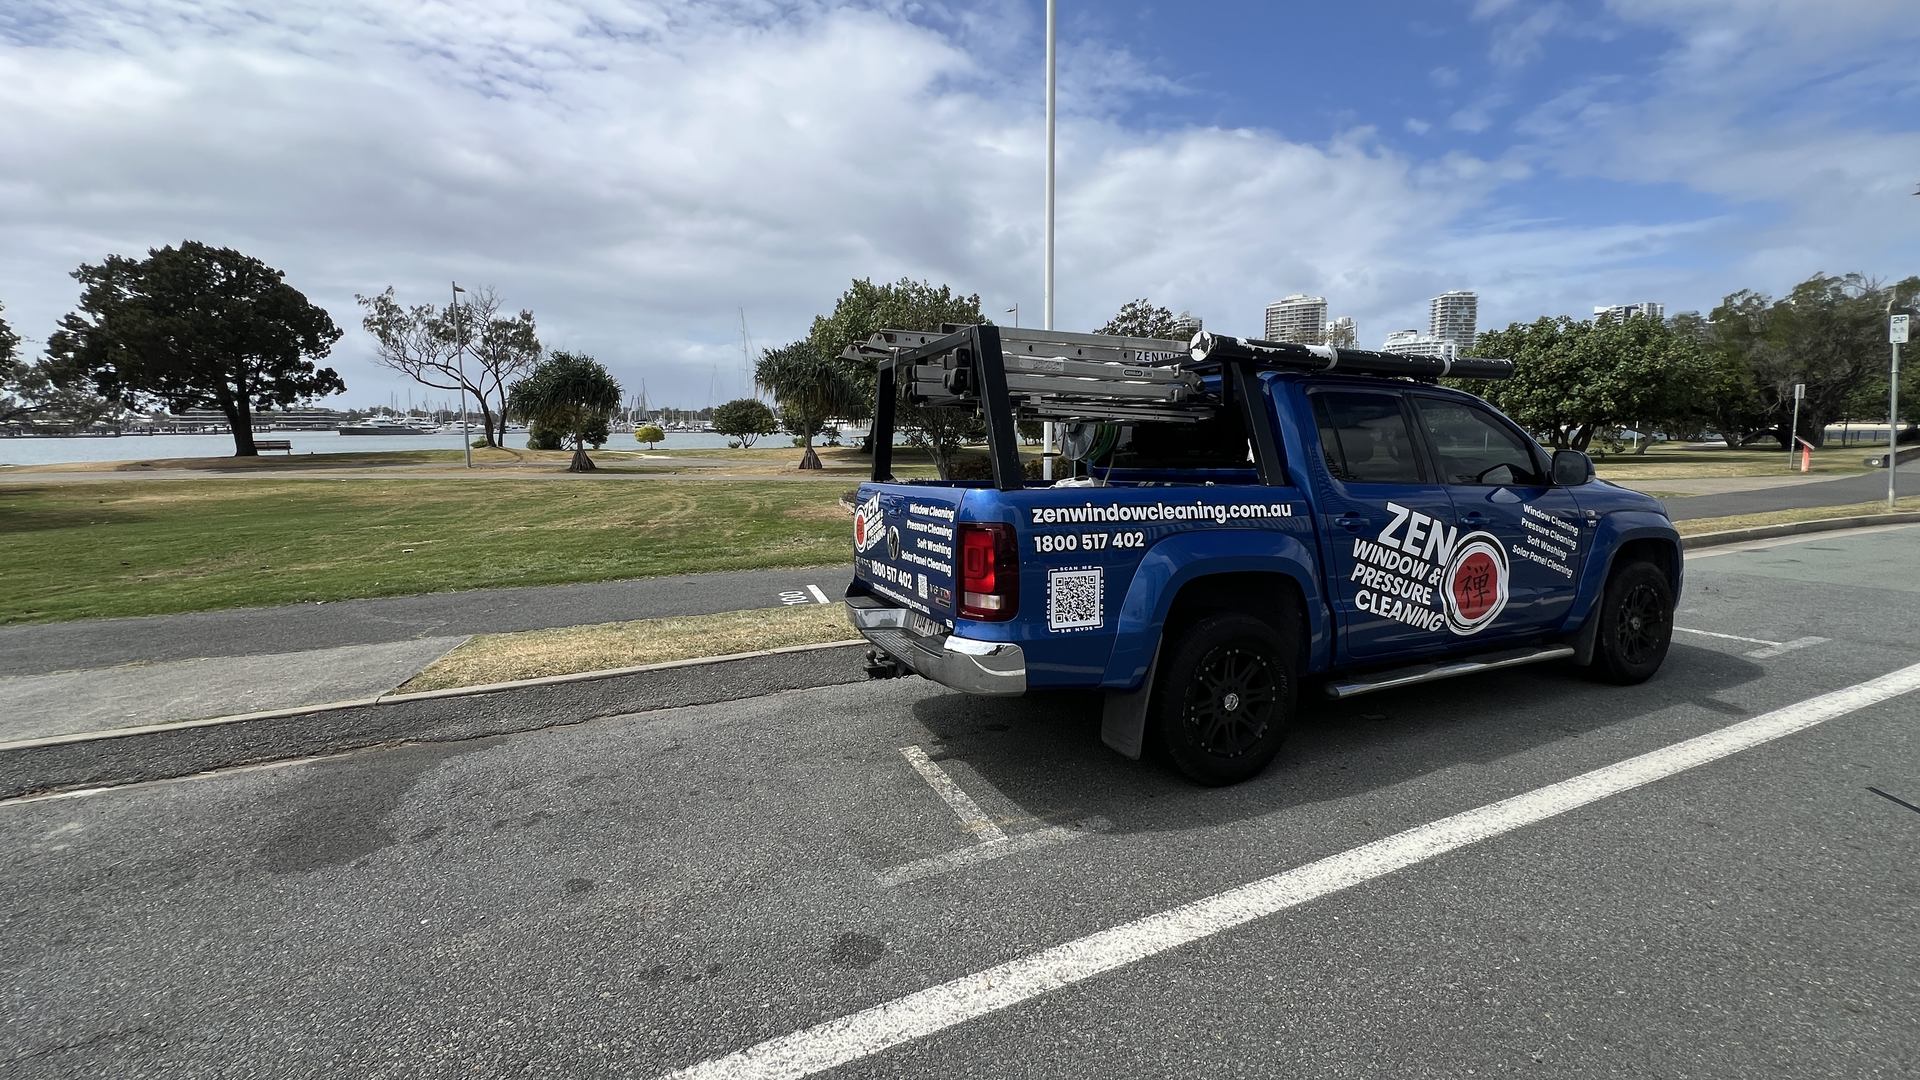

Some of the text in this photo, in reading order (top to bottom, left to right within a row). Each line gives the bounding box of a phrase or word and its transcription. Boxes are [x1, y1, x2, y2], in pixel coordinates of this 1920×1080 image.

[864, 492, 880, 524] ZEN
[909, 502, 954, 522] Window Cleaning
[1032, 502, 1292, 524] zenwindowcleaning.com.au
[1523, 504, 1578, 536] Window Cleaning
[906, 520, 952, 540] Pressure Cleaning
[1034, 532, 1144, 552] 1800 517 402
[1377, 502, 1458, 566] ZEN
[1521, 517, 1577, 550] Pressure Cleaning
[917, 538, 952, 559] Soft Washing
[1352, 538, 1441, 586] WINDOW &
[1512, 544, 1573, 578] Solar Panel Cleaning
[1527, 534, 1568, 561] Soft Washing
[872, 560, 886, 578] 1800
[886, 566, 898, 583] 517
[898, 570, 912, 590] 402
[902, 550, 952, 578] Solar Panel Cleaning
[1350, 563, 1432, 606] PRESSURE
[1355, 590, 1444, 632] CLEANING
